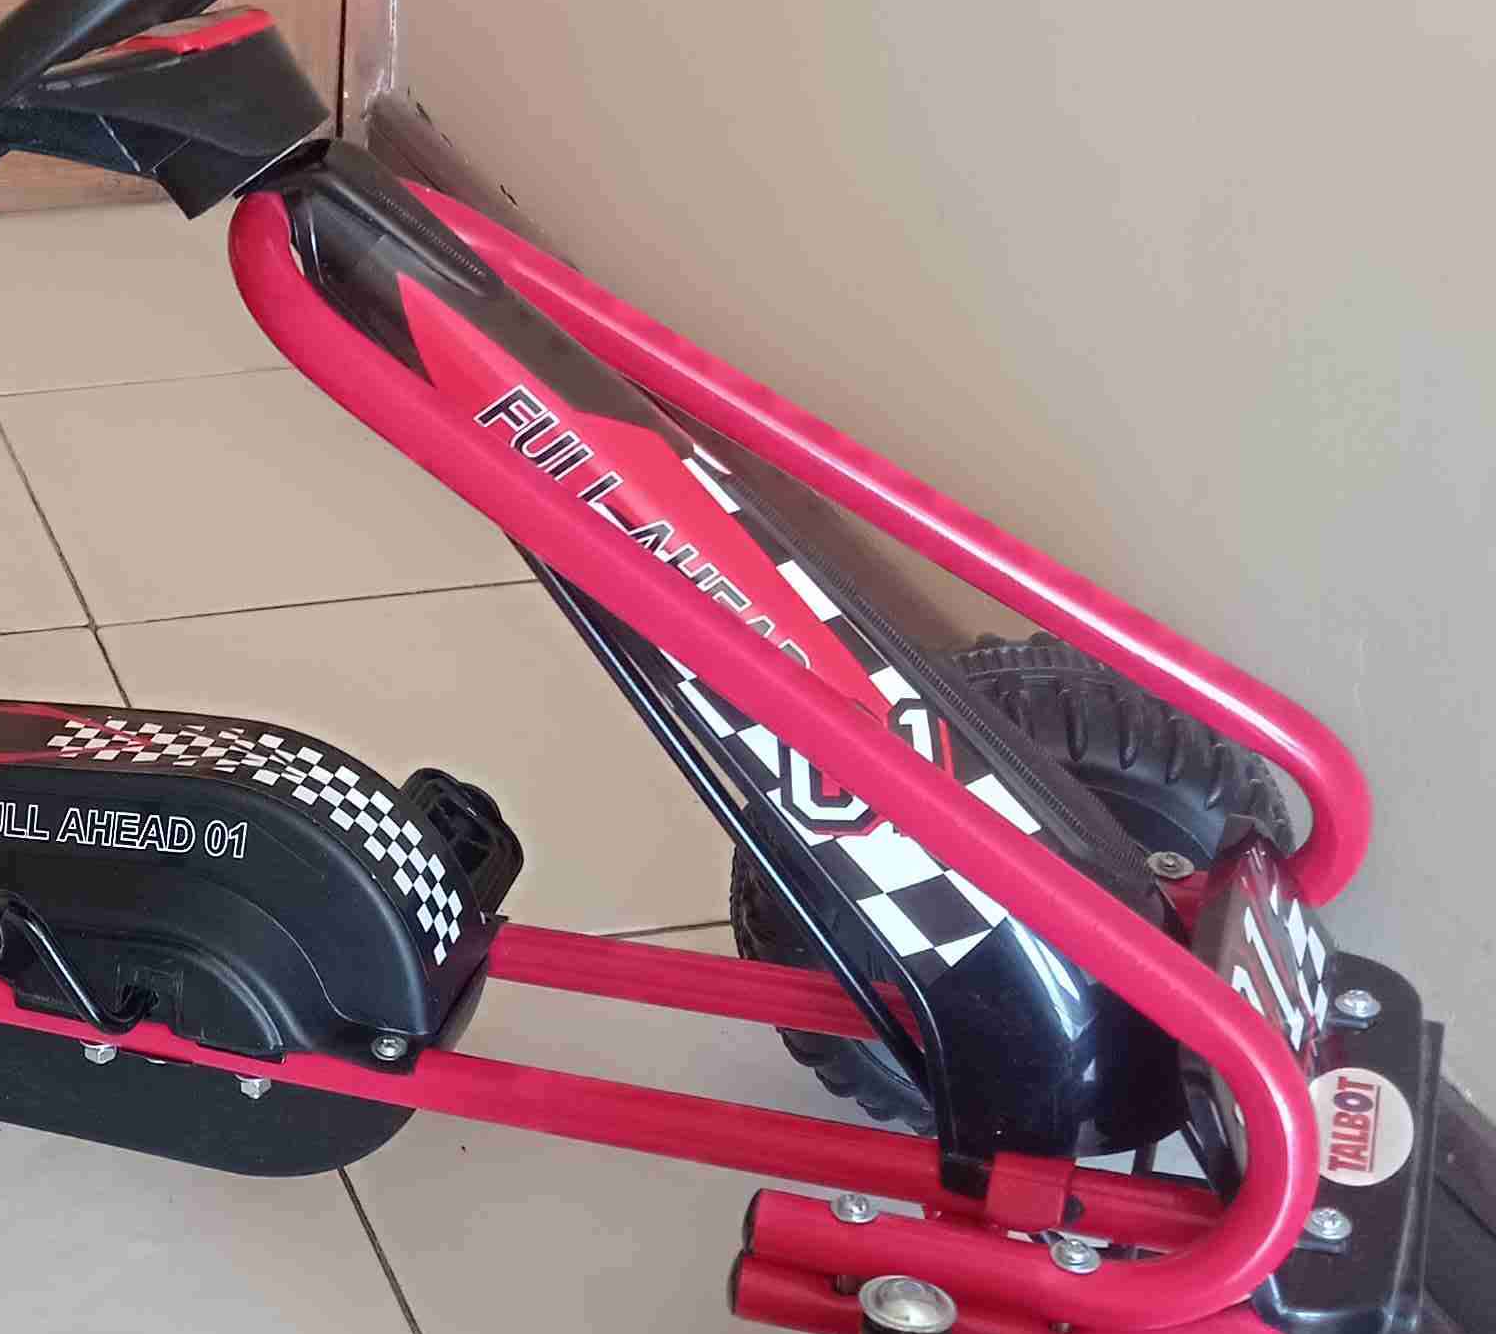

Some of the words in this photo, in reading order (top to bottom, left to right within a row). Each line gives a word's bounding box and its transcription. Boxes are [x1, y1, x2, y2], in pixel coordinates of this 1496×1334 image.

[55, 807, 196, 854] AHEAD
[204, 819, 249, 859] 01
[1327, 1075, 1375, 1172] TALBOT
